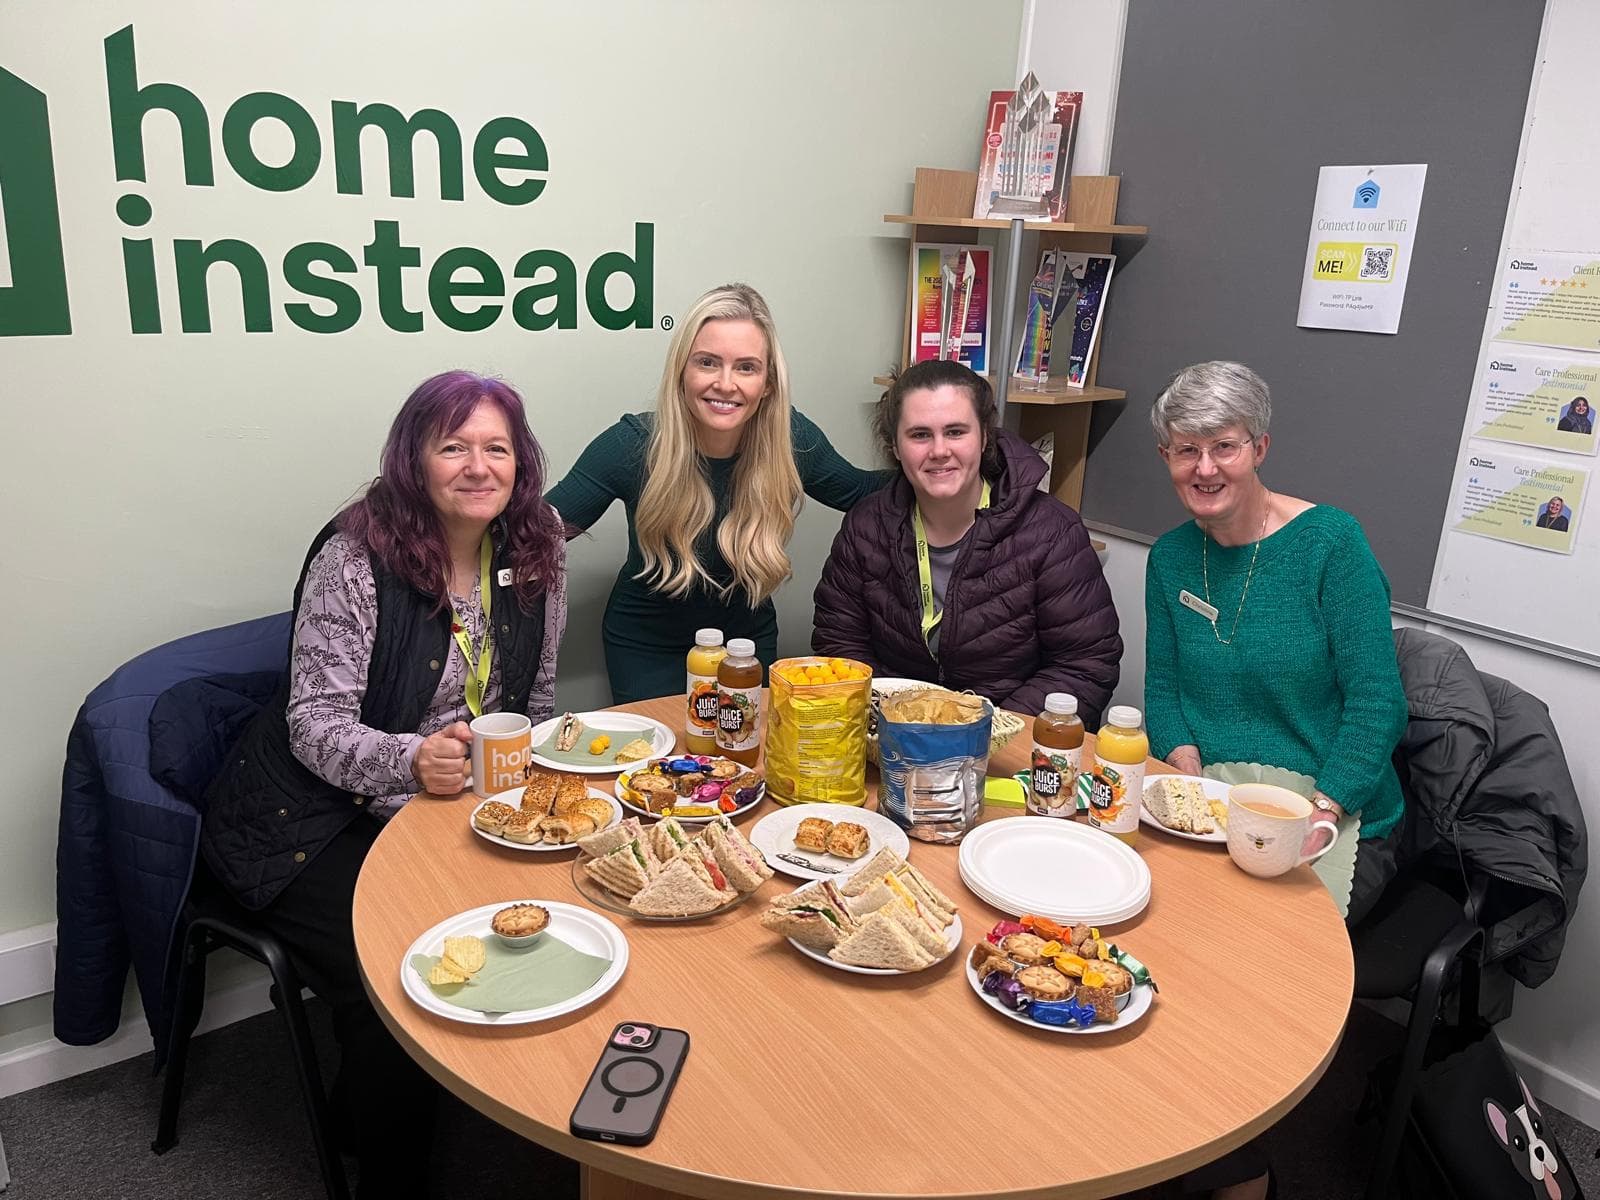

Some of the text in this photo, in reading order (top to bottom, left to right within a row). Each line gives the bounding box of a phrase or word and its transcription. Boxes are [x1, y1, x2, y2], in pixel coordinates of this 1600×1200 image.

[104, 24, 549, 206] home
[1317, 218, 1408, 232] Connect to our Wifi
[1321, 249, 1345, 259] SCAN
[1317, 260, 1344, 274] ME!
[1572, 265, 1595, 276] Client
[1534, 366, 1598, 383] Care Professional
[1541, 378, 1588, 392] Testimonial
[1513, 465, 1575, 484] Care Professional
[1520, 477, 1565, 493] Testimonial
[696, 697, 718, 710] JUIC
[698, 708, 718, 718] BURS
[720, 720, 741, 730] BURST
[1034, 781, 1060, 794] BURST
